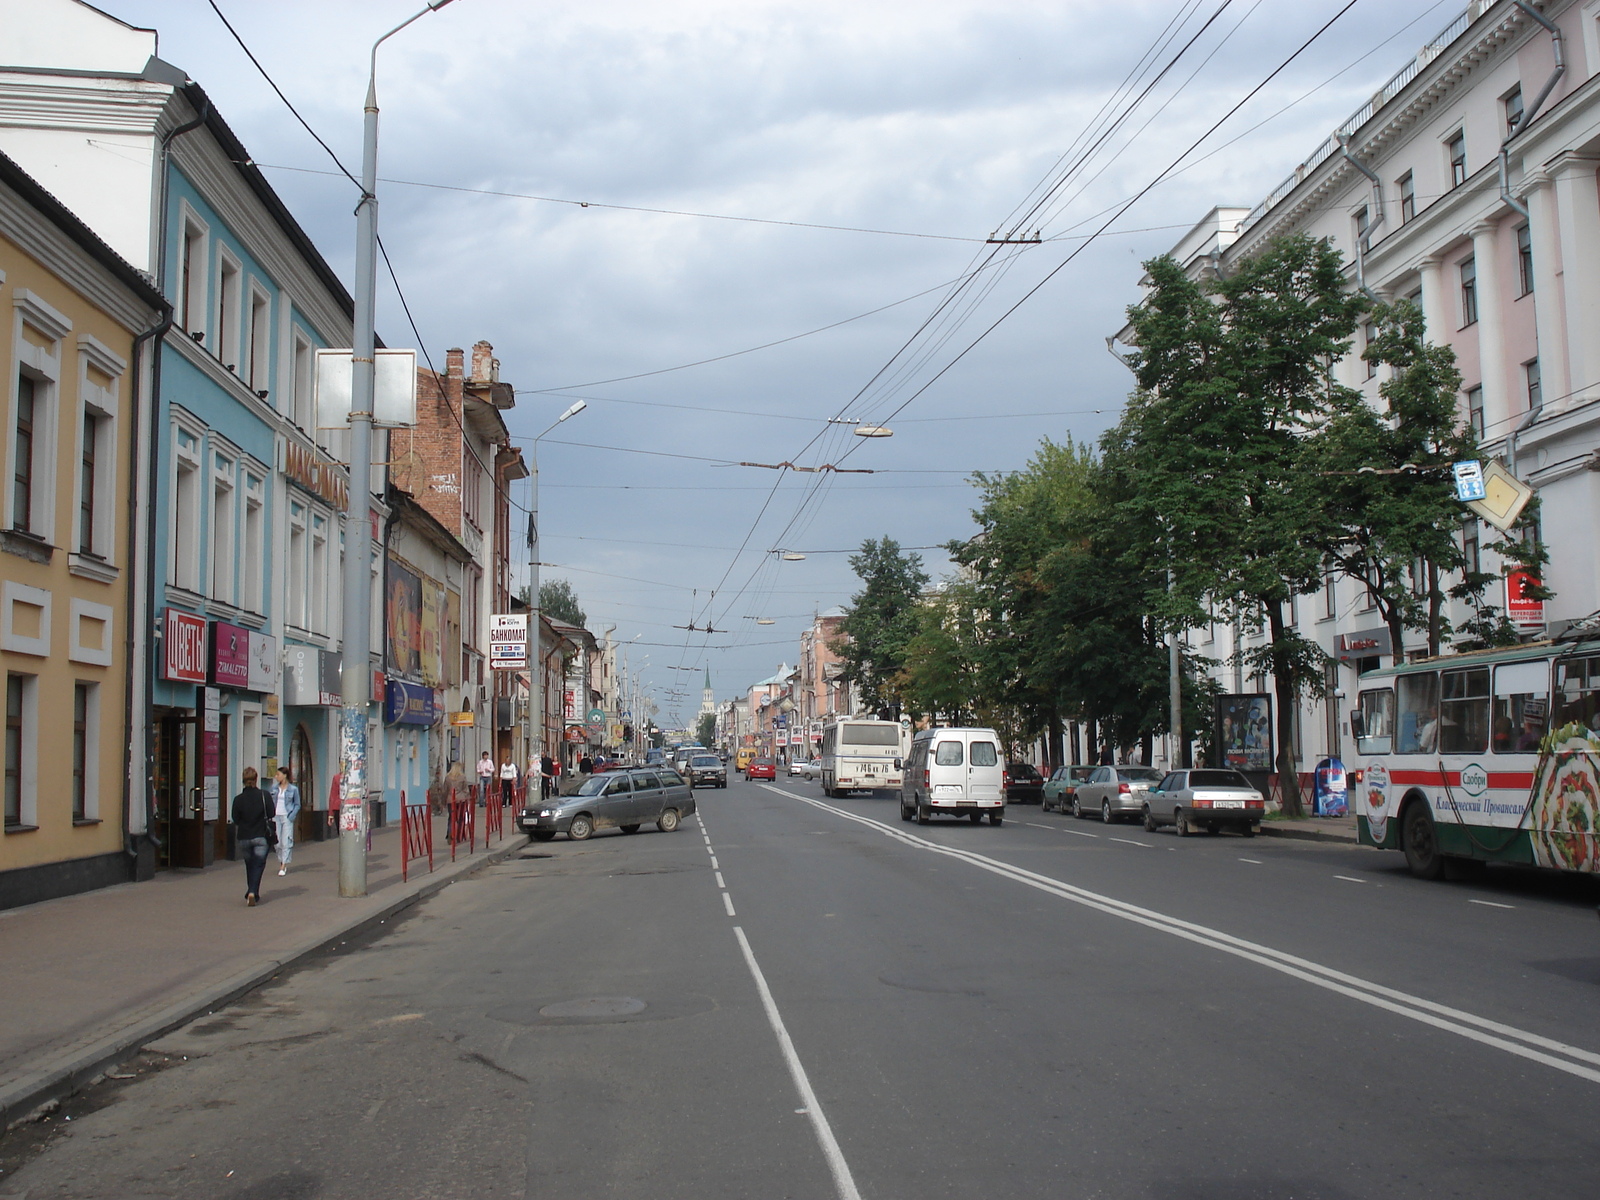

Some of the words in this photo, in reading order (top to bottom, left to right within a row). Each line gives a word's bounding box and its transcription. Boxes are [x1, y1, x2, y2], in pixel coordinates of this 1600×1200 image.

[491, 628, 526, 642] БАНКОМАТ
[169, 619, 205, 674] ЦВЕТЫ
[217, 661, 248, 677] ZIMALETTO
[296, 651, 305, 692] ОБУВЬ
[1462, 772, 1486, 789] Сдобри
